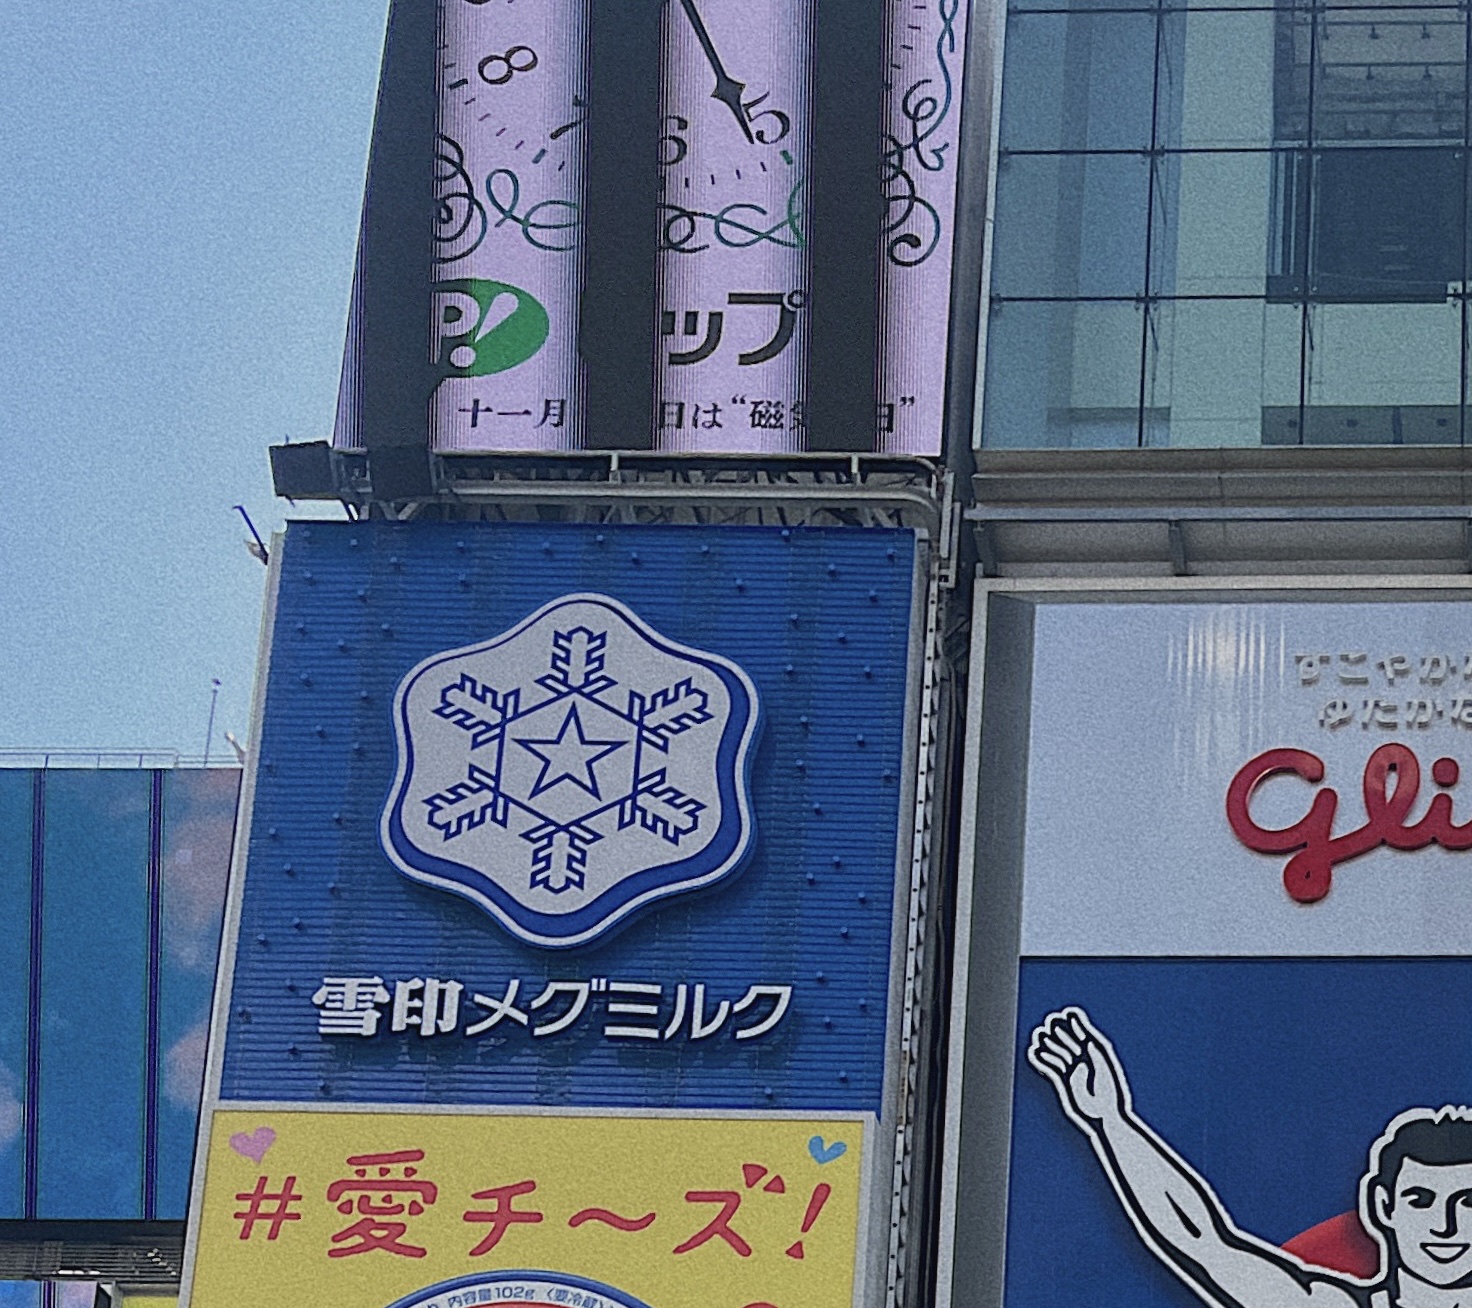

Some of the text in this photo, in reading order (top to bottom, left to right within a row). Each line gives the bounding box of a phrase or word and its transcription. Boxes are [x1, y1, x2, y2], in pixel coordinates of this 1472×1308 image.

[478, 46, 538, 85] 8
[457, 399, 567, 429] 十一月
[310, 975, 793, 1041] 雪印メグミルク
